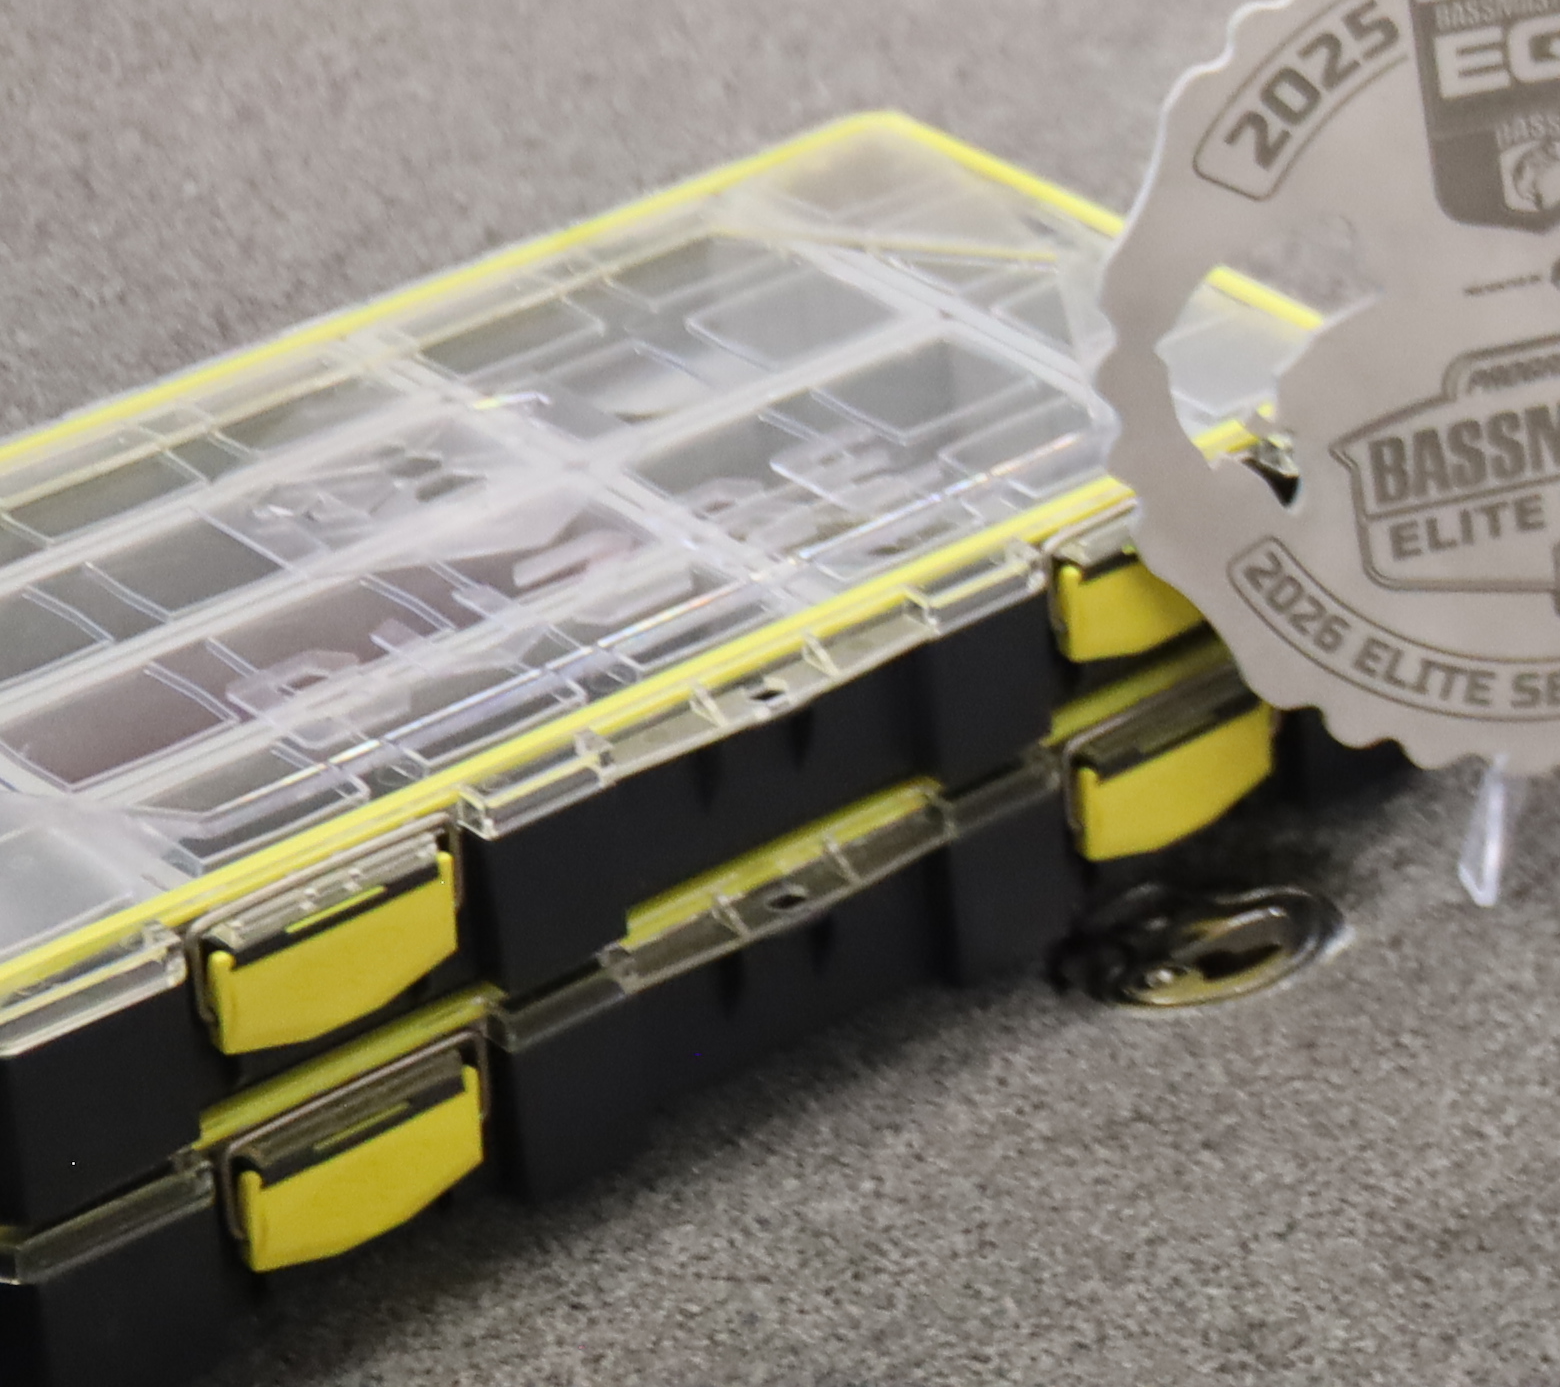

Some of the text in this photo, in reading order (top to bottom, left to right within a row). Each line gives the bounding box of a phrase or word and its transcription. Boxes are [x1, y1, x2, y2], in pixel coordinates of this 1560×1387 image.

[1389, 493, 1547, 562] ELITE
[1243, 550, 1345, 654] 2026
[1352, 632, 1495, 708] ELITE
